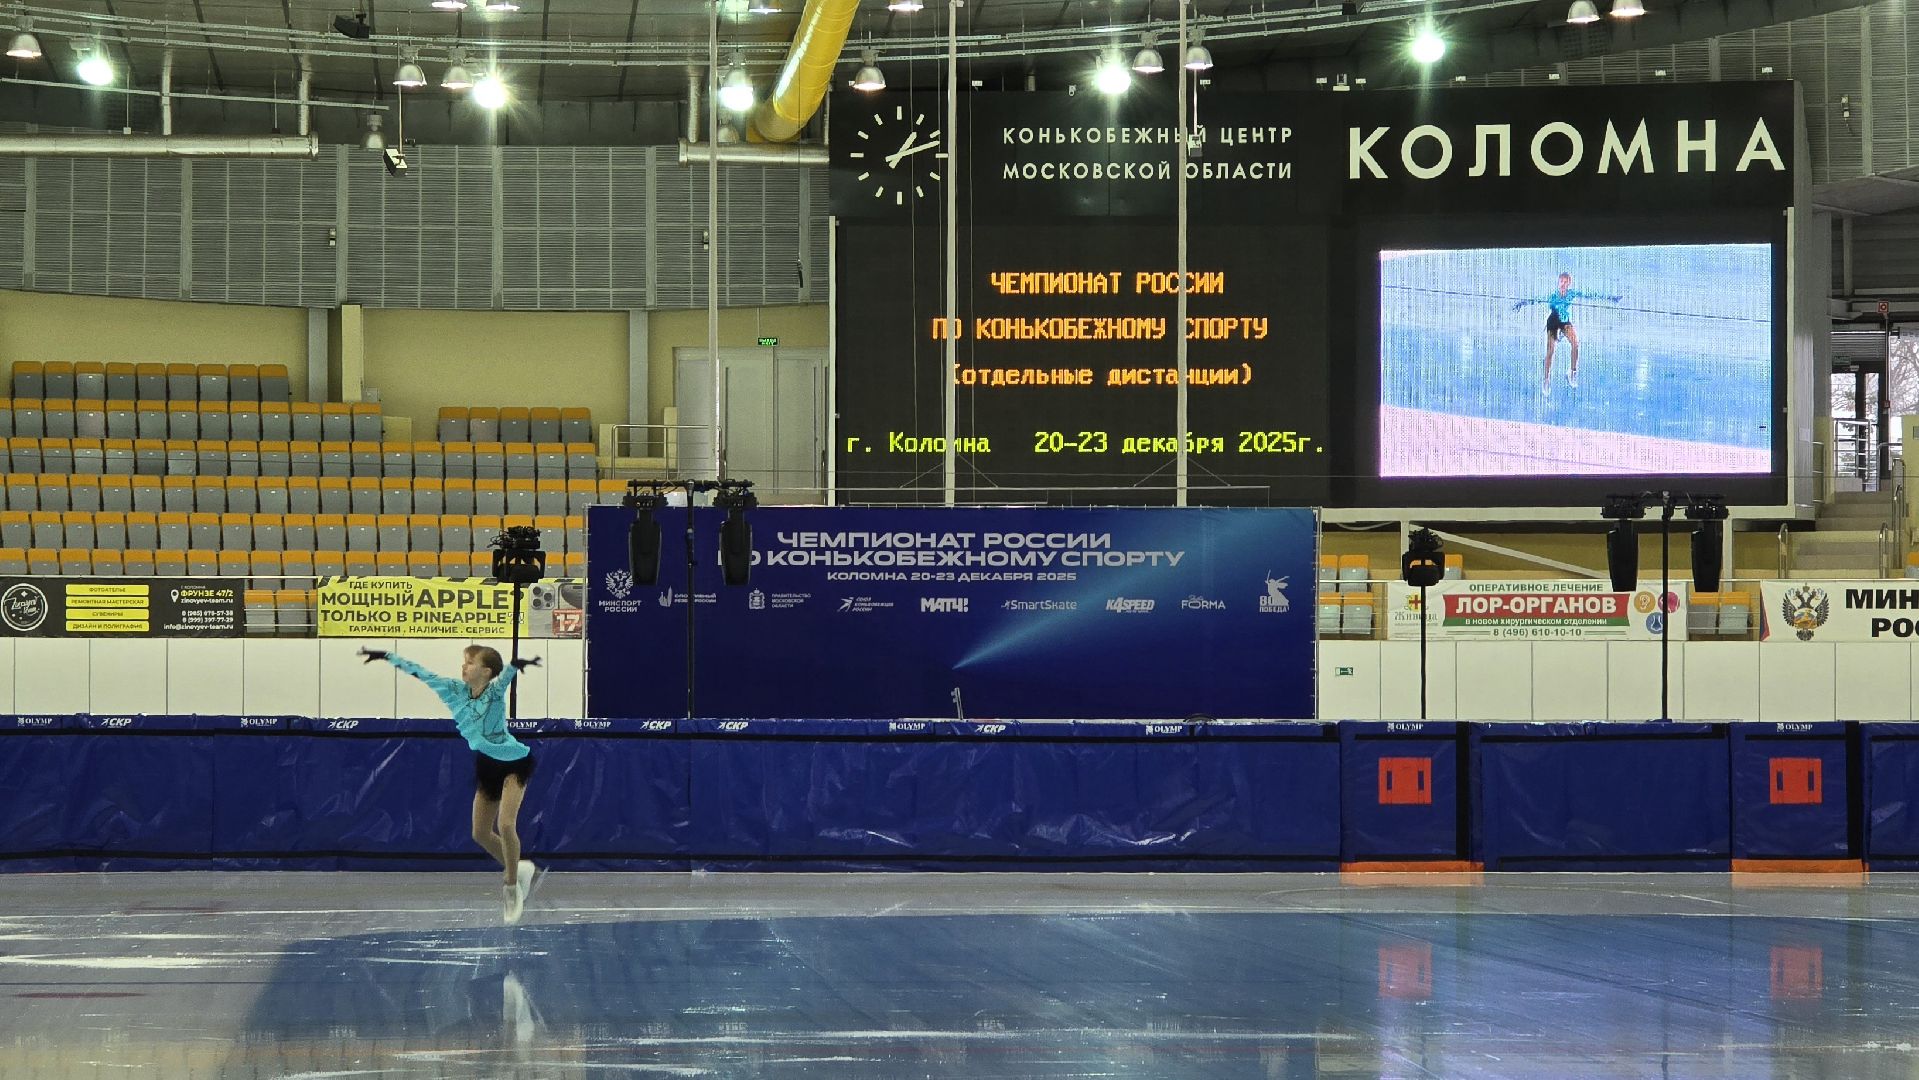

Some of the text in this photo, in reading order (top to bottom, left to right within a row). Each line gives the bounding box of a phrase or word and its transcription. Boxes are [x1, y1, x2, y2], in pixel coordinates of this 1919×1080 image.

[1220, 127, 1293, 146] ЦЕНТР
[1349, 117, 1786, 180] КОЛОМНА
[1003, 161, 1293, 179] МОСКОВСКОЙ ОБЛАСТИ
[991, 272, 1224, 294] ЧЕМПИОНАТ РОССИИ
[976, 318, 1165, 339] КОНЬКОБЕЖНОМУ
[1185, 318, 1268, 339] СПОРТУ
[1107, 363, 1252, 386] дистанции)
[847, 437, 872, 453] г.
[1034, 431, 1108, 453] 20-23
[1121, 432, 1224, 454] декабря
[1239, 431, 1323, 453] 2025г.
[777, 532, 1111, 548] ЧЕМПИОНАТ РОССИИ
[767, 550, 1058, 567] КОНЬКОБЕЖНОМУ
[1061, 551, 1185, 567] СПОРТУ
[827, 572, 1076, 582] КОЛОМНА 20-23 ДЕКАБРЯ 2025
[216, 589, 234, 597] 47/2
[349, 581, 413, 590] ГДЕ КУПИТЬ
[1469, 583, 1604, 592] ОПЕРАТИВНОЕ ЛЕЧЕНИЕ
[321, 590, 415, 607] МОЩНЫЙ
[921, 598, 969, 612] МАТЧ!
[1181, 600, 1226, 610] FORMA
[1455, 597, 1617, 614] ЛОР-ОРГАНОВ
[321, 610, 391, 622] ТОЛЬКО
[396, 611, 408, 622] В
[1500, 618, 1562, 626] хирургическом
[1563, 618, 1608, 626] отделении
[349, 625, 505, 634] ГАРАНТИЯ НАЛИЧИЕ СЕРВИС
[1502, 628, 1529, 637] (496)
[1871, 618, 1919, 637] РО
[1154, 725, 1183, 733] OLYMP
